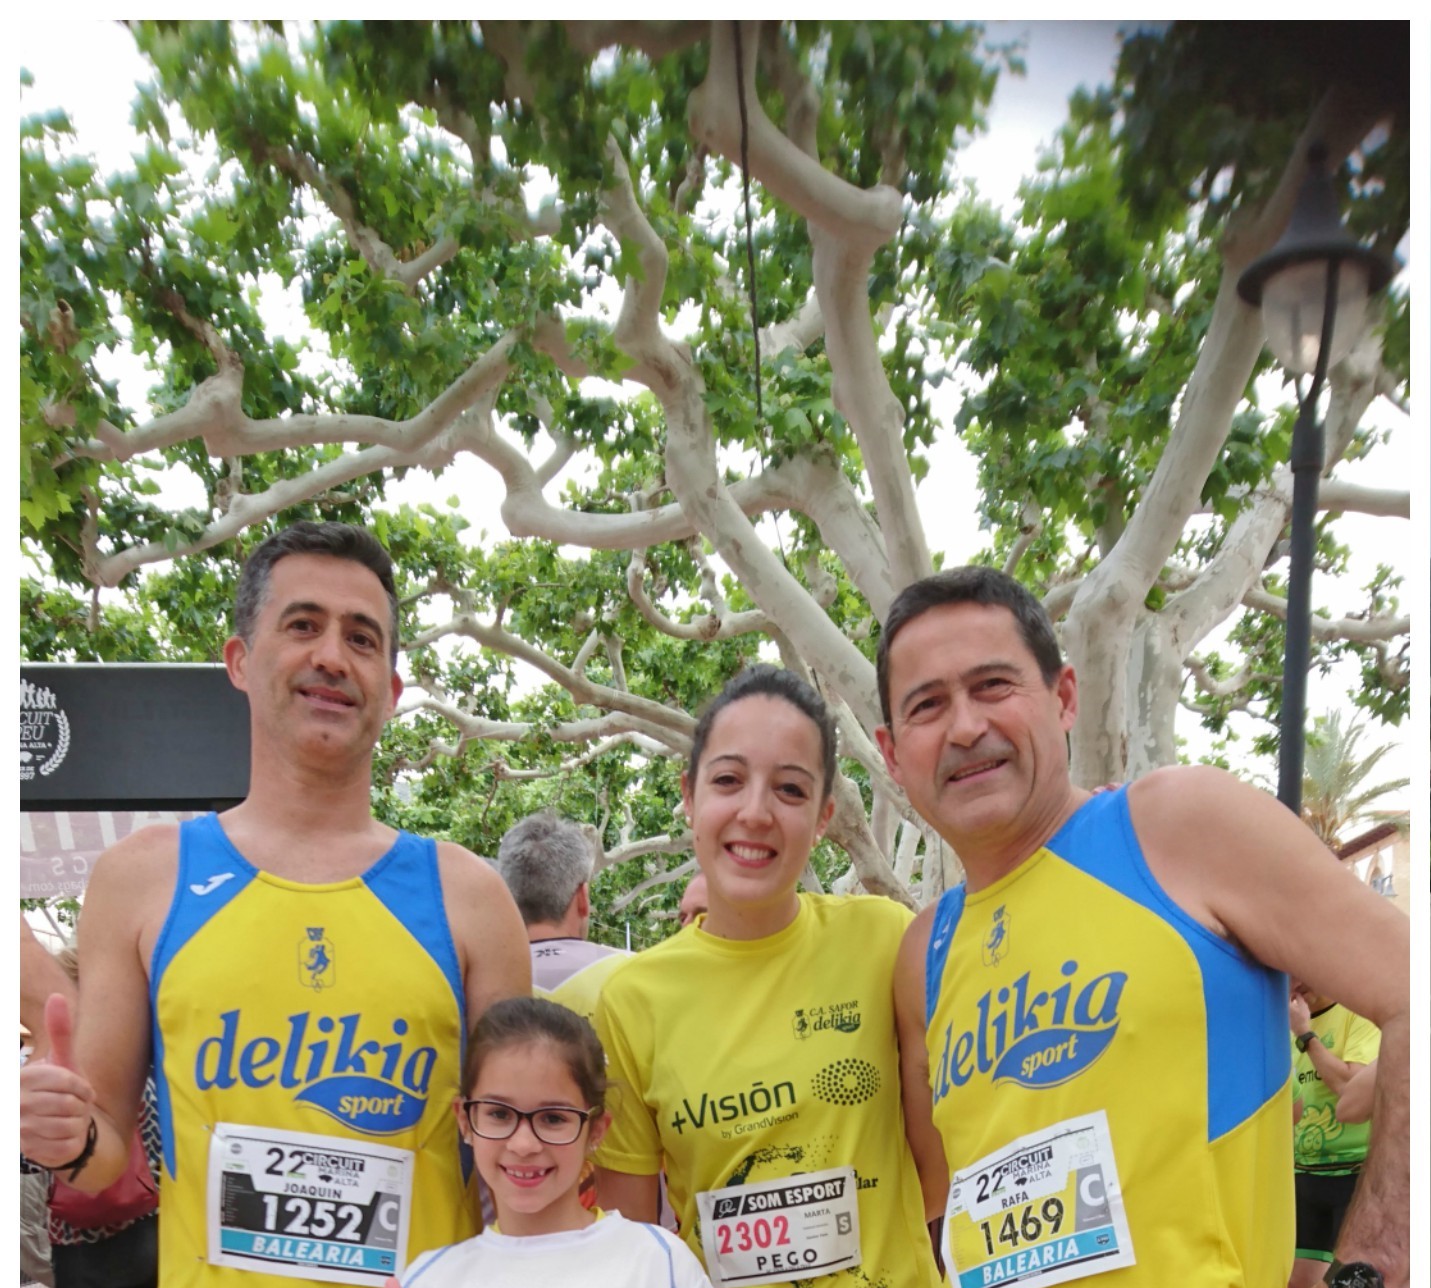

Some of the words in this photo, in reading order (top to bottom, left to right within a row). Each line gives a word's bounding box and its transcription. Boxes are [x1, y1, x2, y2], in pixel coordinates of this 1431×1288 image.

[828, 1000, 859, 1013] SAFOR
[813, 1011, 862, 1032] delikia
[933, 960, 1129, 1107] delikia
[195, 1009, 438, 1095] delikia
[1020, 1033, 1079, 1079] sport
[338, 1094, 405, 1120] sport
[721, 1129, 733, 1139] by
[265, 1147, 307, 1177] 22
[302, 1152, 365, 1172] CIRCUIT
[976, 1167, 1002, 1204] 22
[1000, 1146, 1054, 1178] CIRCUIT
[1012, 1161, 1052, 1180] MARINA
[333, 1177, 360, 1188] ALTA
[1029, 1169, 1053, 1184] ALTA
[283, 1183, 342, 1200] JOAQUIN
[748, 1192, 782, 1212] SOM
[785, 1180, 843, 1205] ESPORT
[1001, 1190, 1030, 1210] RAFA
[1080, 1174, 1104, 1207] C
[262, 1194, 364, 1242] 1252
[378, 1201, 399, 1231] C
[804, 1208, 831, 1219] MARTA
[838, 1215, 850, 1232] S
[980, 1197, 1064, 1256] 1469
[717, 1215, 791, 1255] 2302
[756, 1248, 818, 1272] PEGO
